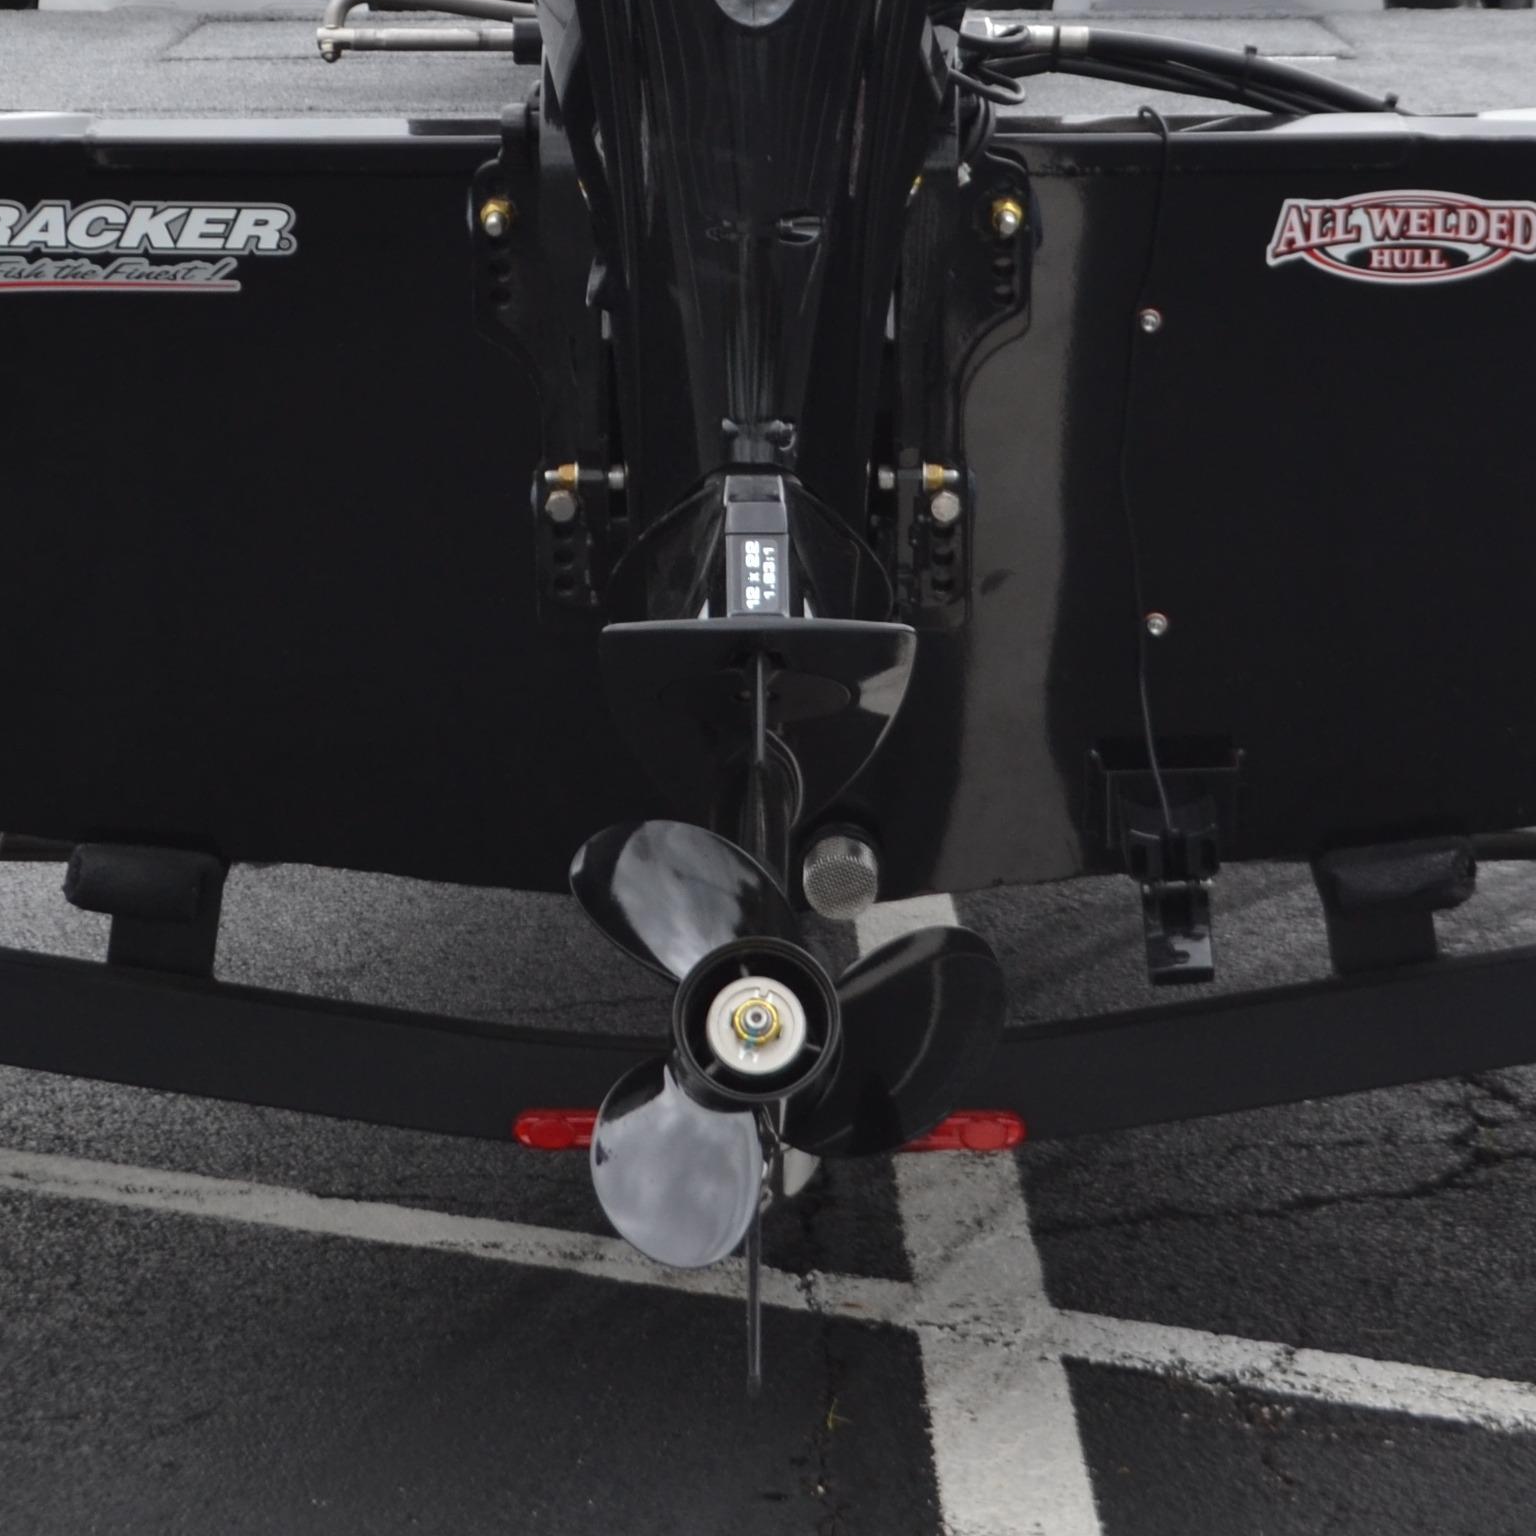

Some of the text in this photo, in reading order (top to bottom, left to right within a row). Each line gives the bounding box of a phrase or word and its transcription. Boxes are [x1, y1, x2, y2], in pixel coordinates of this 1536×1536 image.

[1272, 205, 1362, 258] ALL
[52, 261, 98, 280] the
[1368, 248, 1448, 270] HULL
[745, 541, 760, 568] 22
[745, 586, 760, 610] 12
